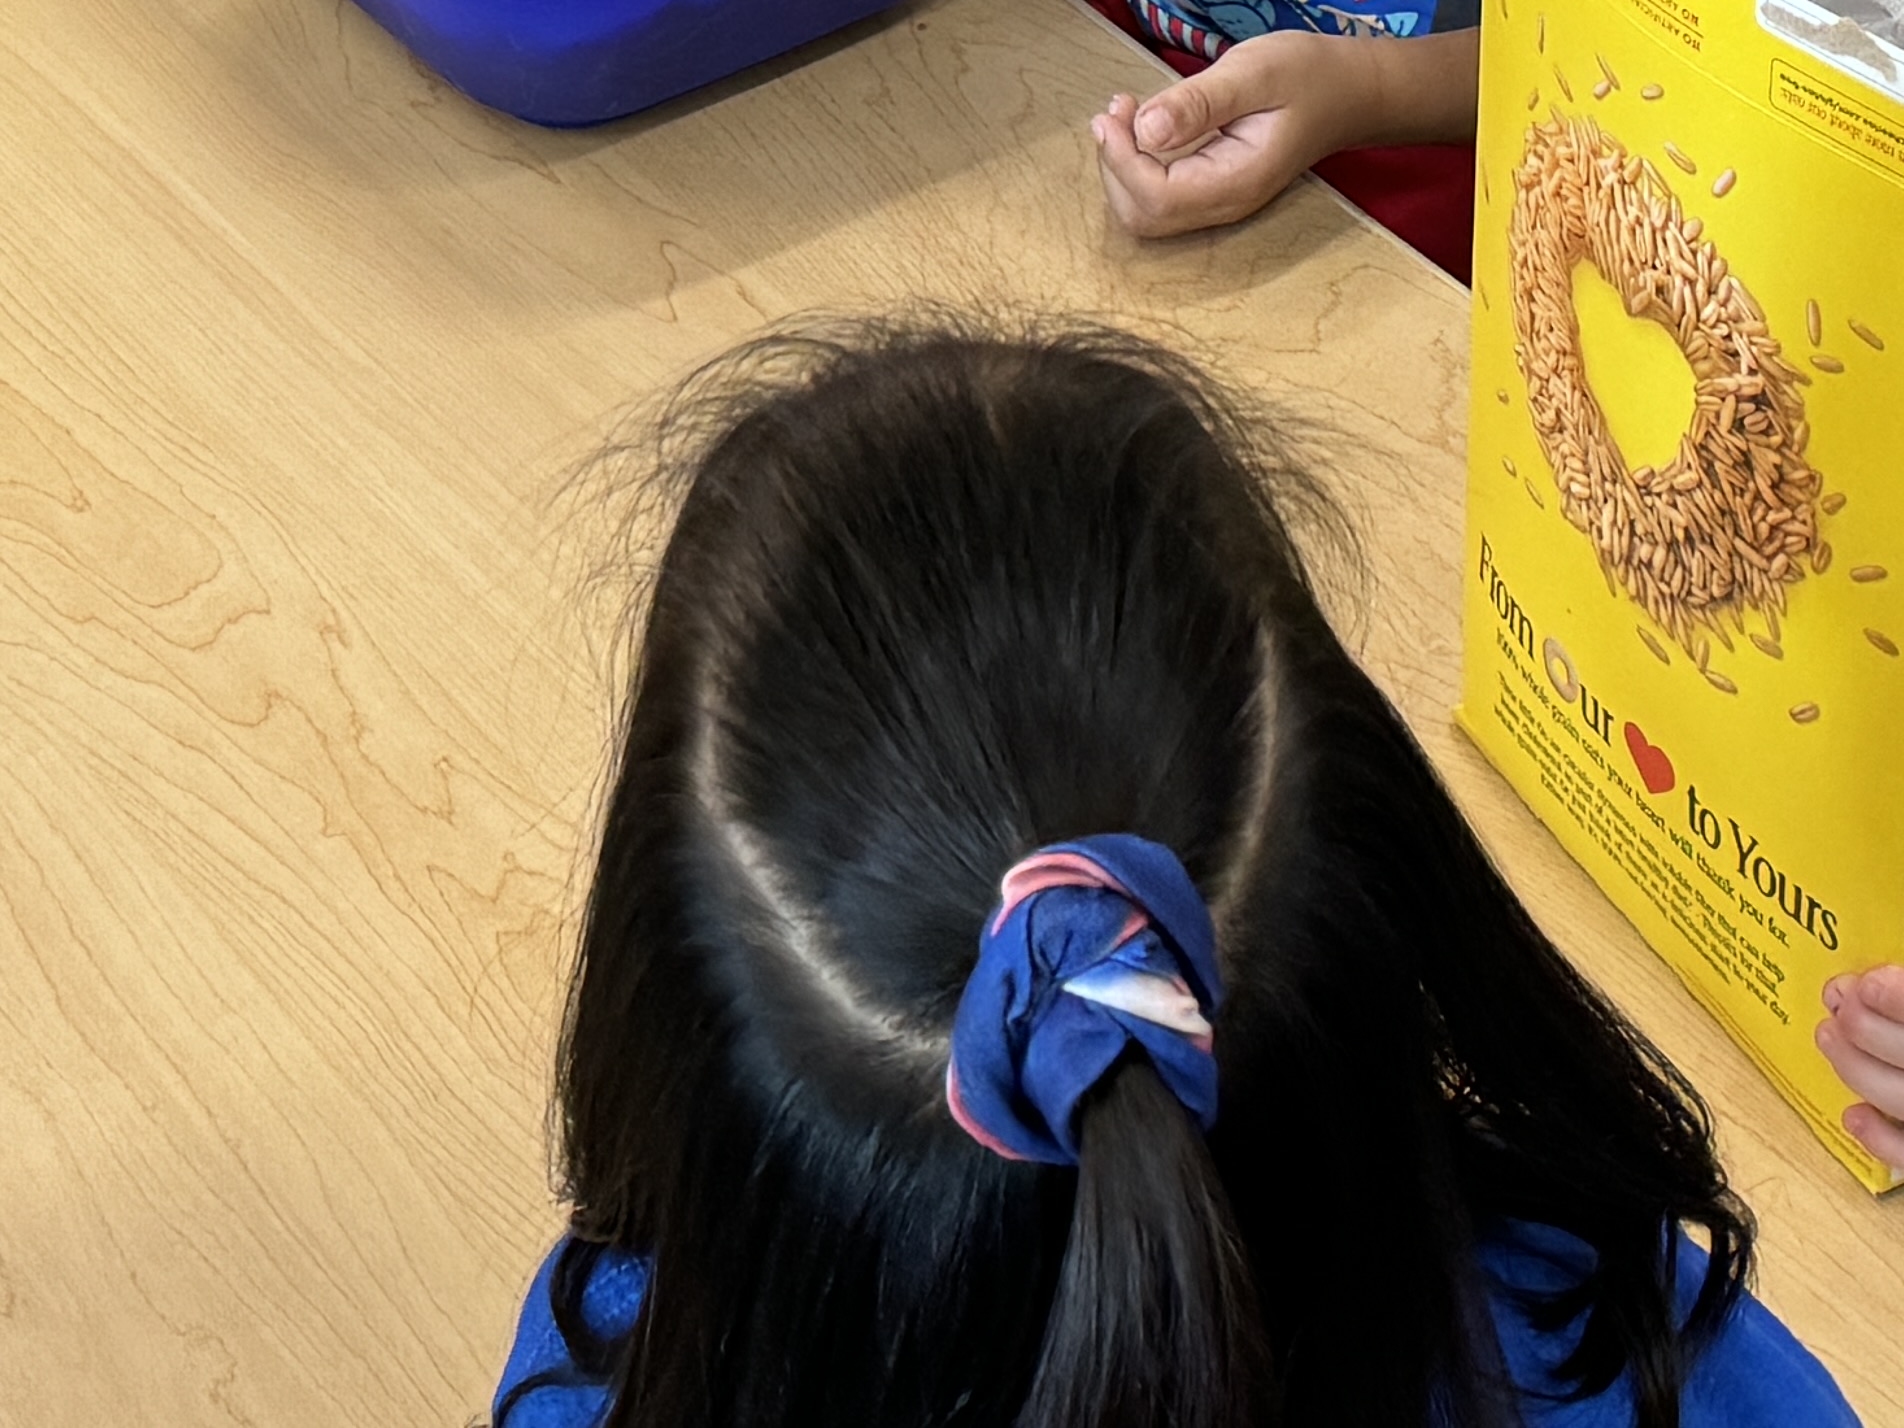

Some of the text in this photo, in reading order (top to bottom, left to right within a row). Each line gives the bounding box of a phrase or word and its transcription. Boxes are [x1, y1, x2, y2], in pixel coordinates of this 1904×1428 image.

[1479, 533, 1536, 662] From
[1687, 784, 1723, 850] to
[1728, 817, 1840, 951] Yours
[1738, 893, 1764, 927] you
